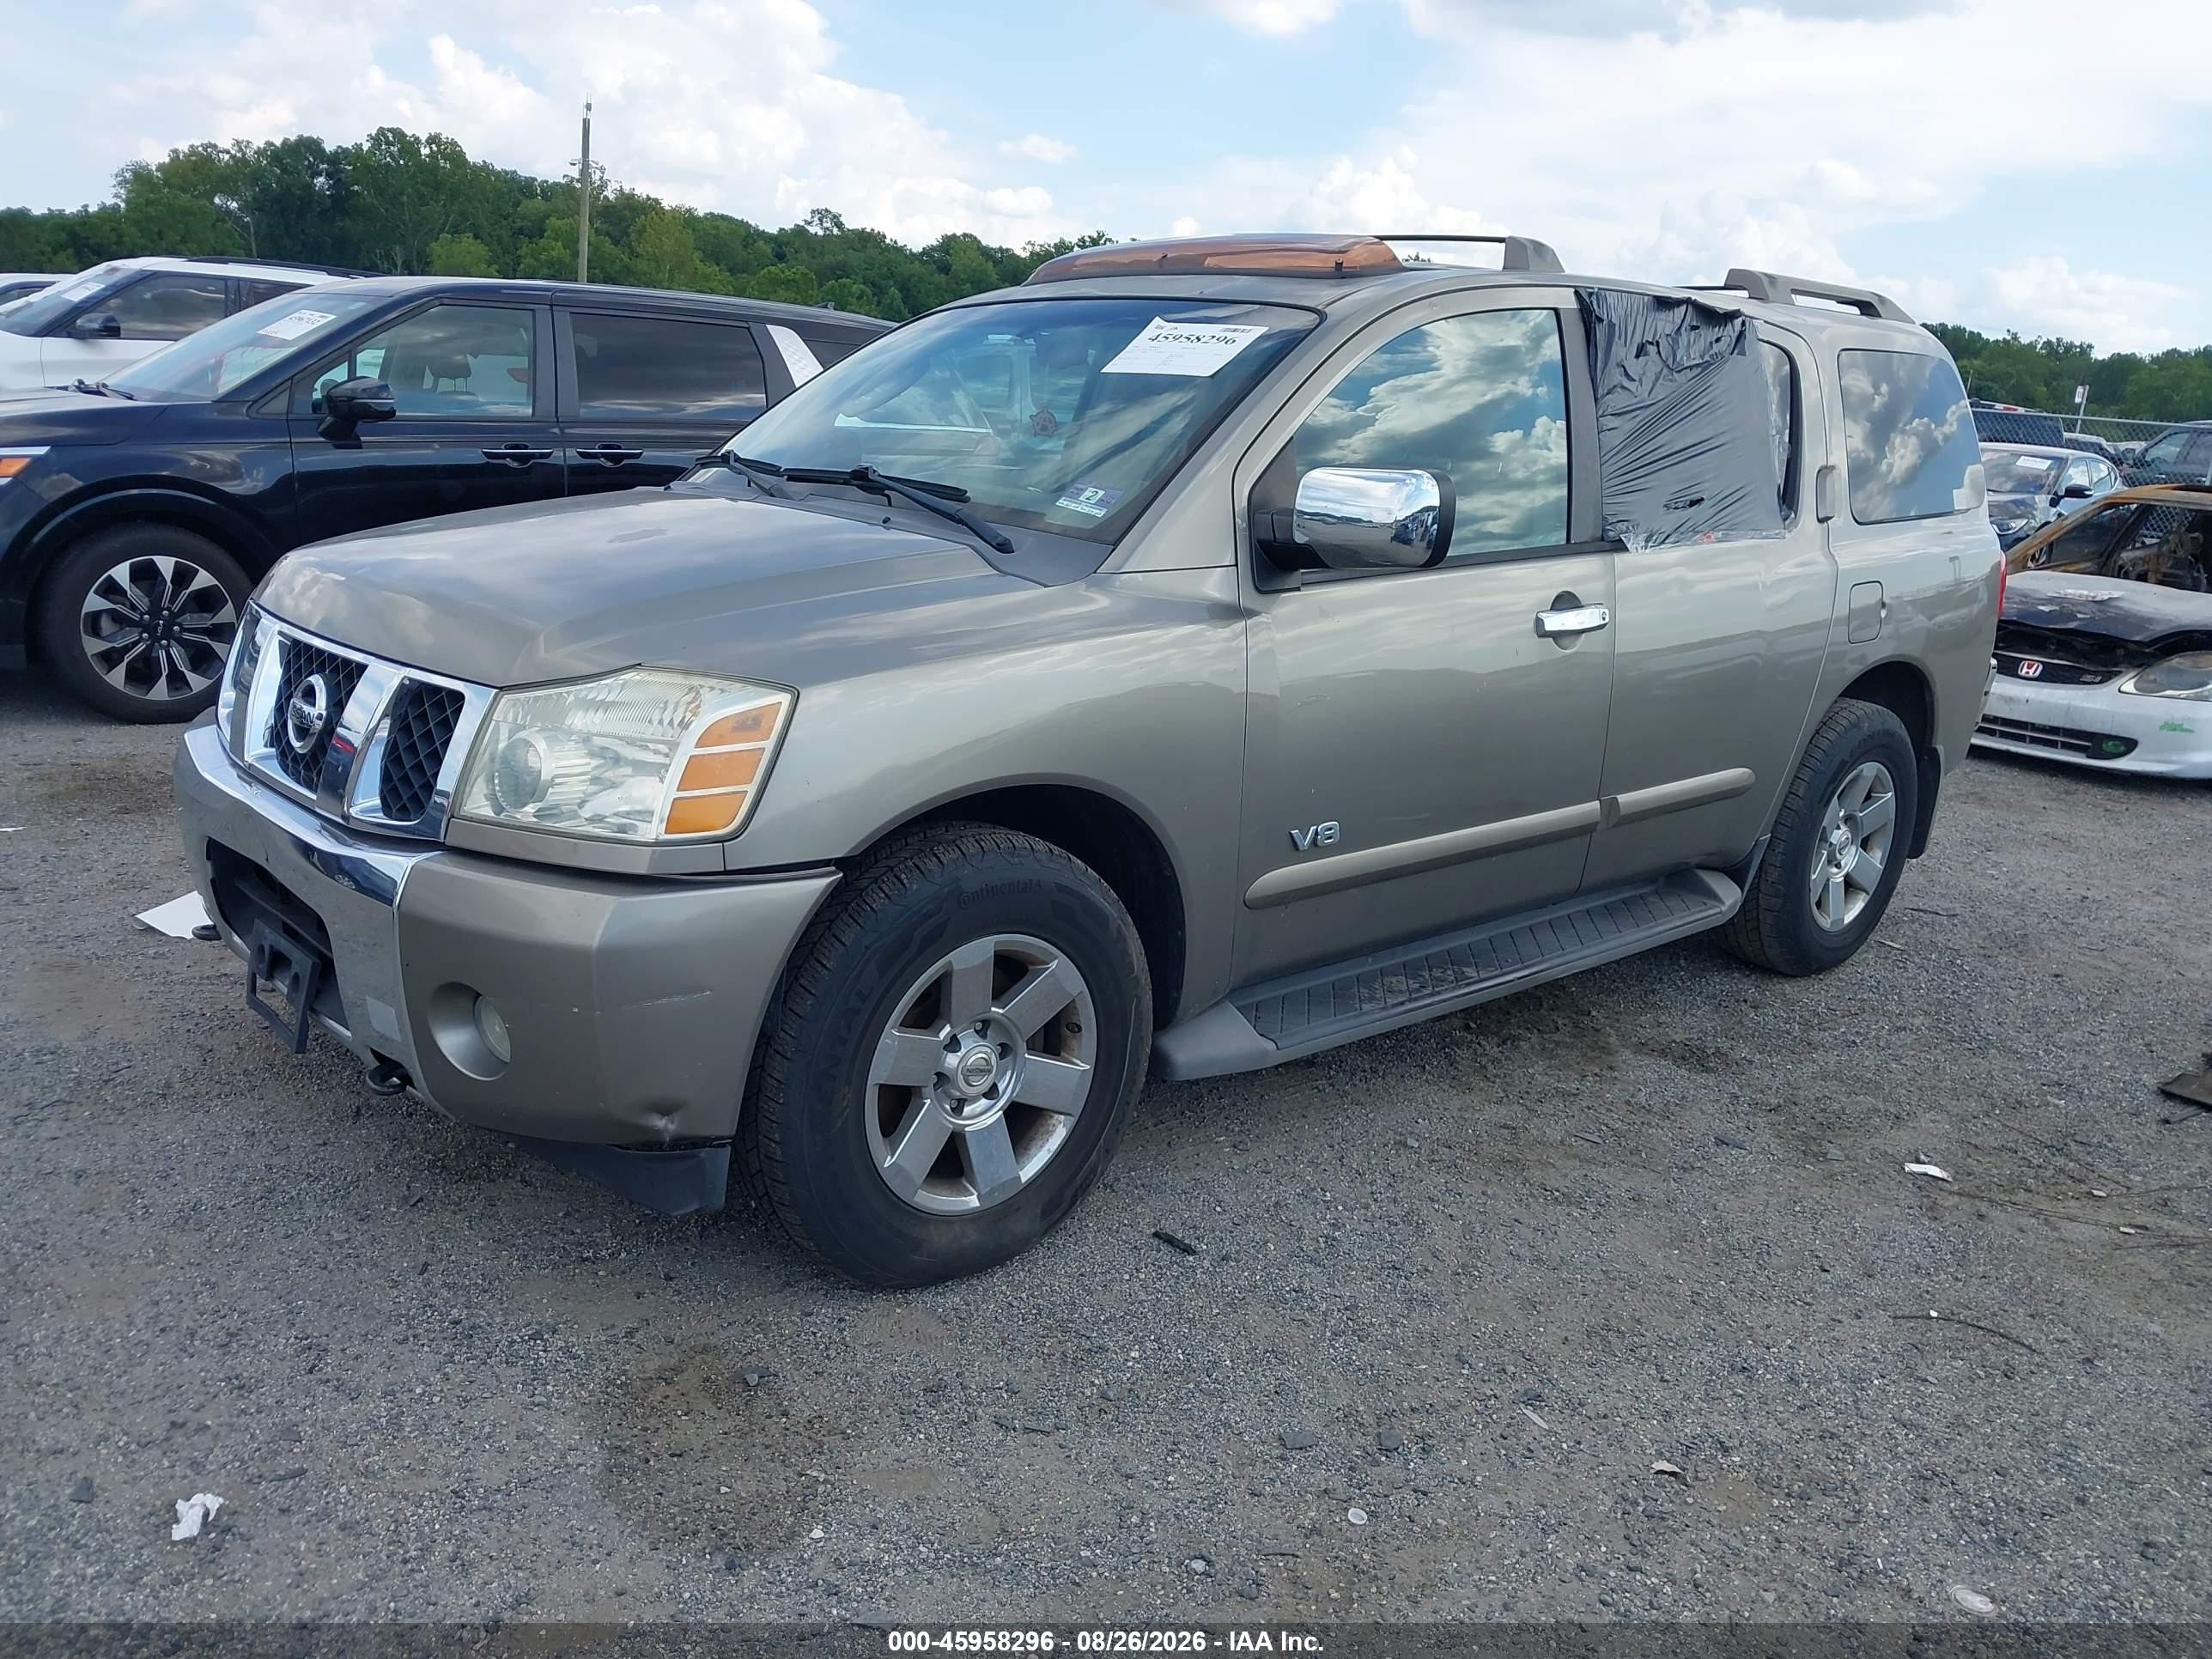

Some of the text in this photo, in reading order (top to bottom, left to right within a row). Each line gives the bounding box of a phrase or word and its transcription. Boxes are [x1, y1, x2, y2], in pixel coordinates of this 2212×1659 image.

[1147, 332, 1239, 345] 45958296
[1085, 490, 1098, 501] 2
[1289, 821, 1340, 851] V8
[957, 878, 1033, 909] Continental
